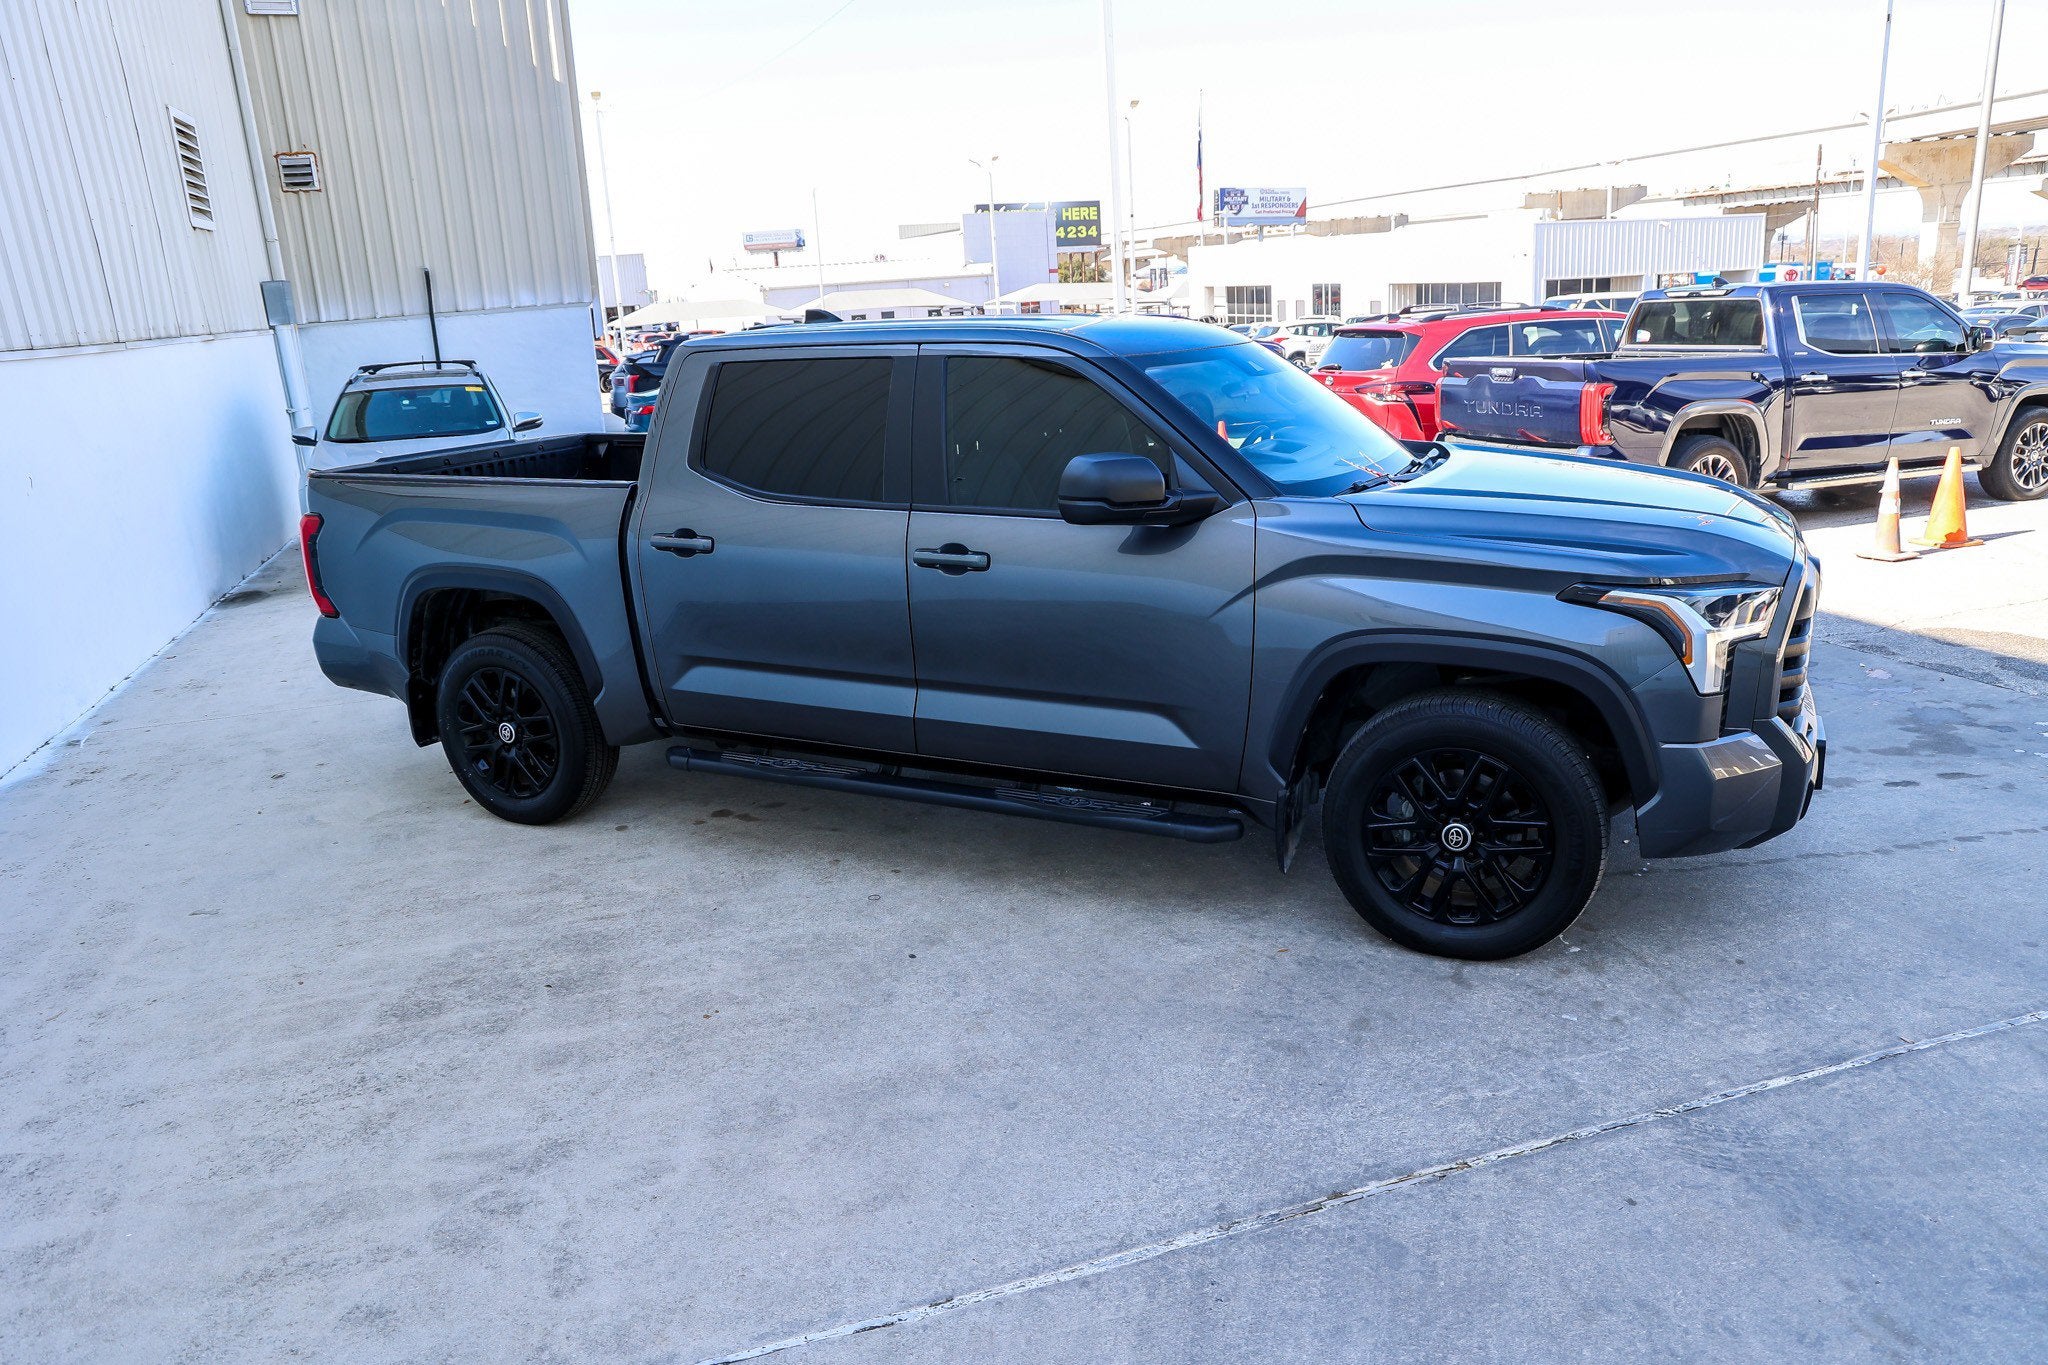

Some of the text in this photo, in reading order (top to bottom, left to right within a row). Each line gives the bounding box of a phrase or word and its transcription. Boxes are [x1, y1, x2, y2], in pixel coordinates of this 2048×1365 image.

[1062, 206, 1098, 221] HERE
[1056, 225, 1098, 239] 4234
[1464, 399, 1544, 418] TUNDRA
[1929, 418, 1962, 426] TUNDRA
